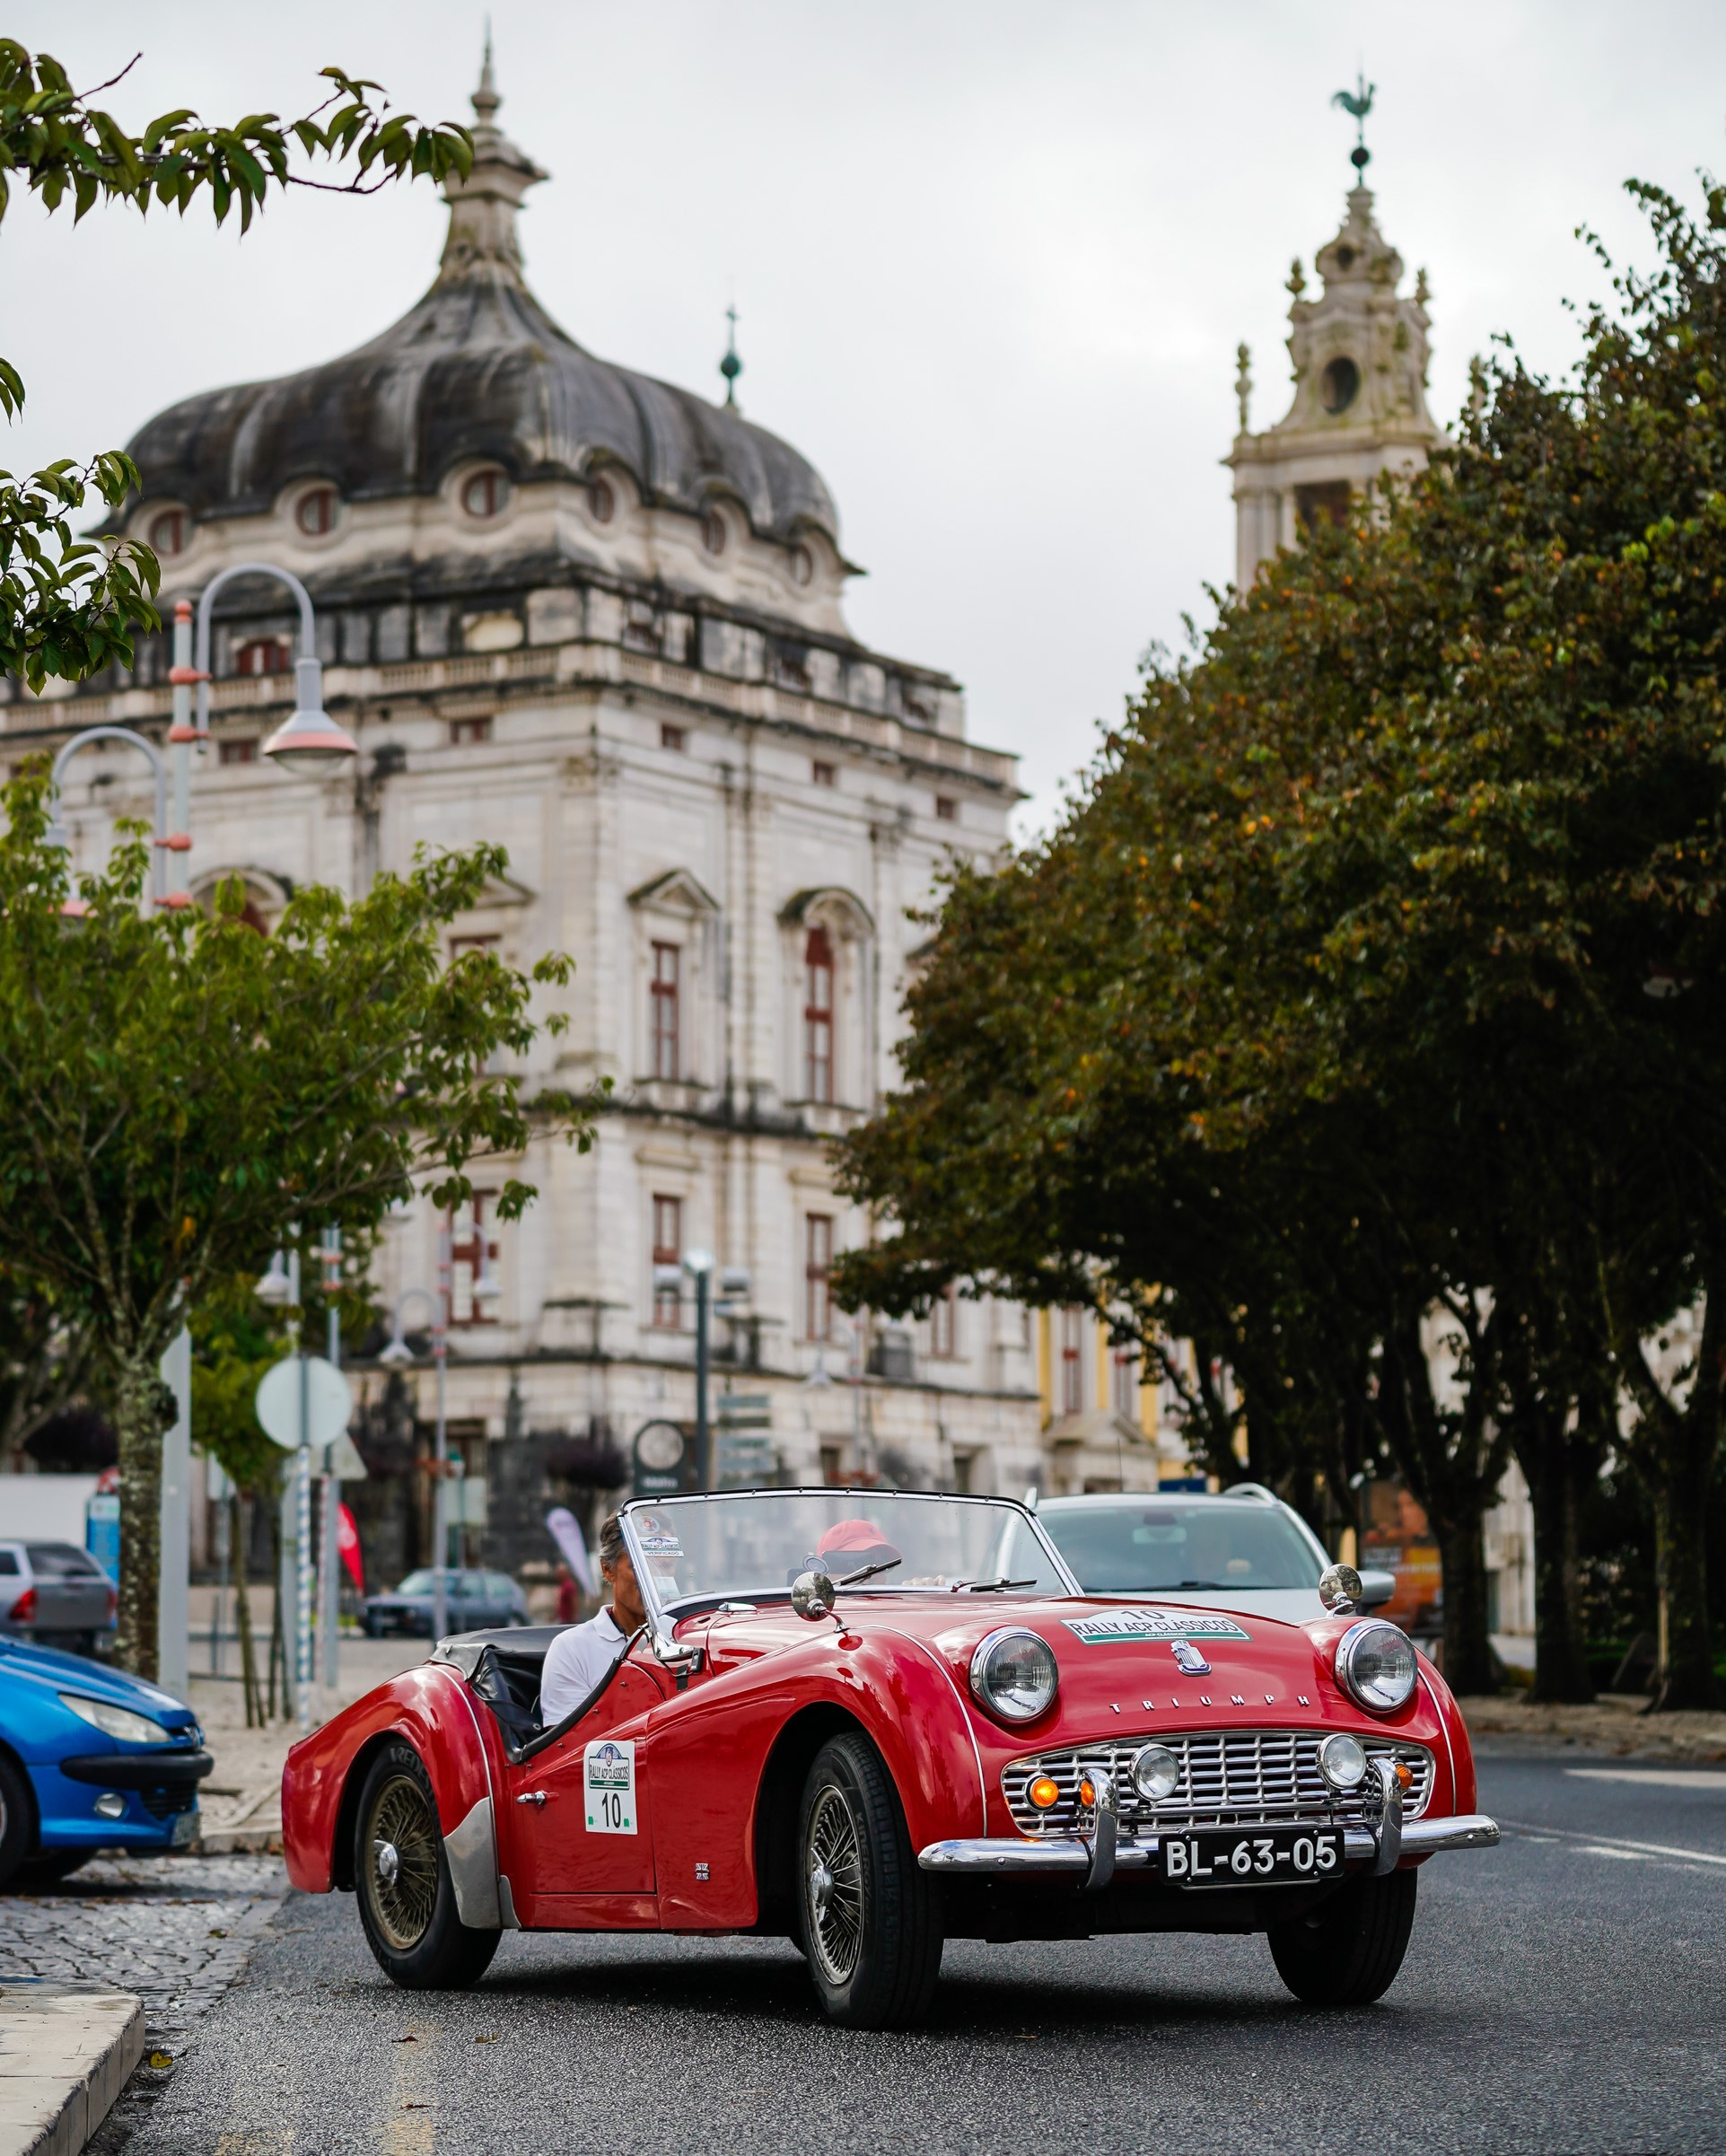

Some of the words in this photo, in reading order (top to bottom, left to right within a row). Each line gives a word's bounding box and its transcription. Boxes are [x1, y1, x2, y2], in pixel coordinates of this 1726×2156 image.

[1121, 1609, 1166, 1620] 10
[1068, 1622, 1124, 1635] RALLY
[1124, 1621, 1153, 1633] ACP
[1154, 1618, 1239, 1632] CLÁSSICOS
[1109, 1694, 1310, 1713] TRIUMPH
[589, 1764, 600, 1779] RALLY
[602, 1792, 621, 1828] 10
[1166, 1836, 1336, 1878] BL-63-05
